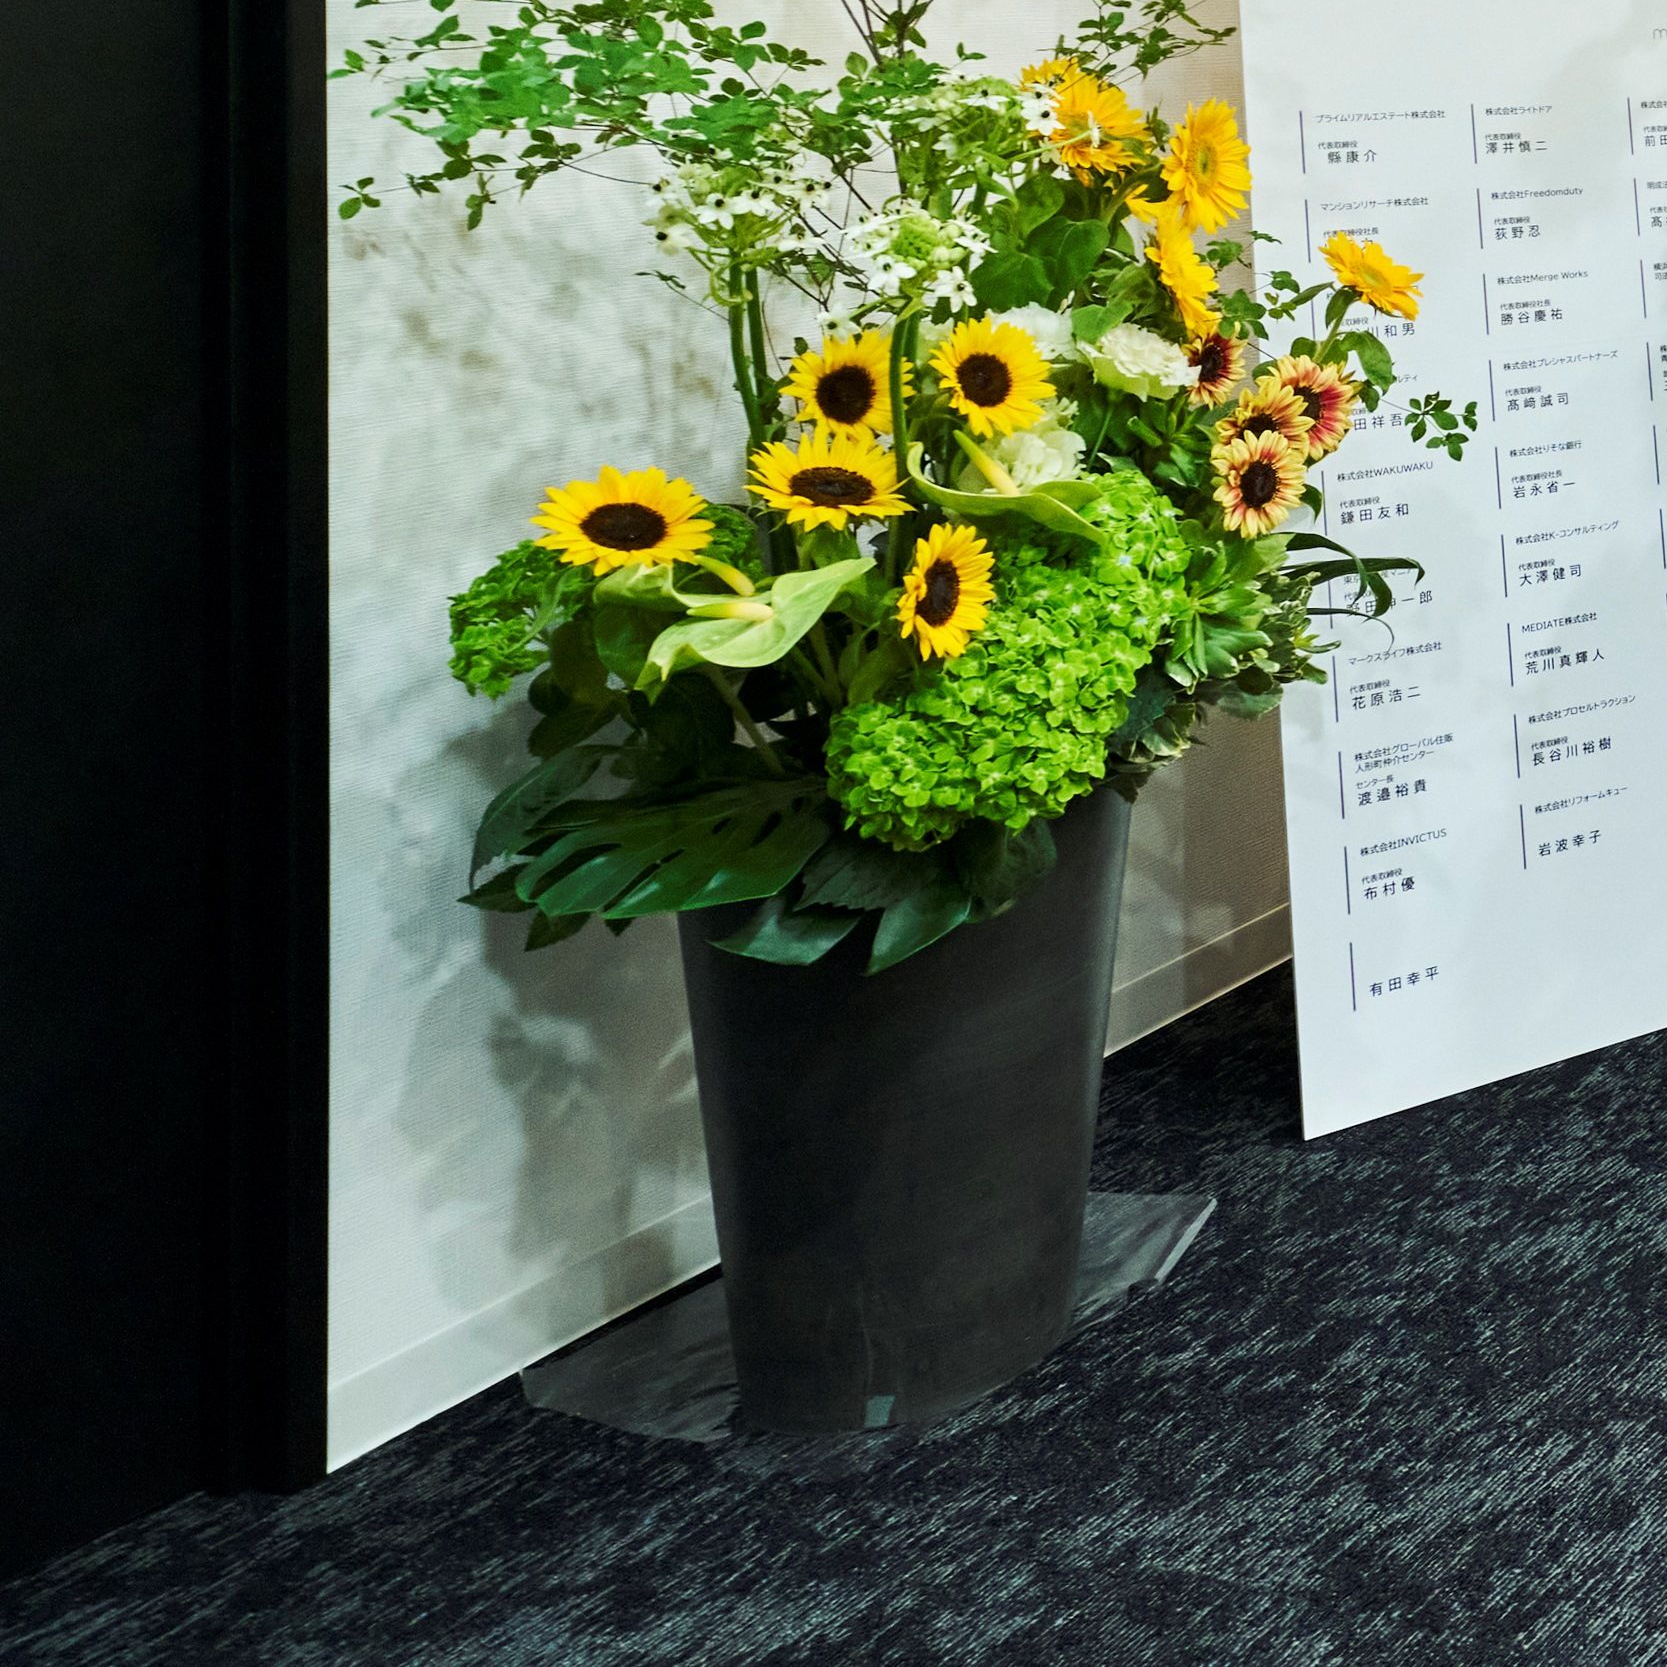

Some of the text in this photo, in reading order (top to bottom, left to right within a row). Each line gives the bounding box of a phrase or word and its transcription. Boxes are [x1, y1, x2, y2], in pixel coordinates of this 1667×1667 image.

[1315, 110, 1447, 124] プライムリアルエステート株式会社
[1485, 105, 1552, 116] 株式会社ライトドア
[1318, 140, 1358, 150] 代表取締役
[1485, 132, 1521, 141] 代表取締役
[1491, 187, 1583, 200] 株式会社Freedomduty
[1320, 196, 1430, 212] マンションリサーチ株式会社
[1494, 216, 1530, 225] 代表取締役
[1497, 270, 1588, 285] 株式会社Merge Works
[1500, 299, 1551, 311] 代表取締役社長
[1503, 350, 1618, 371] 株式会社プレシャスパートナーズ
[1505, 386, 1541, 396] 代表取締役
[1354, 413, 1403, 431] 田祥吾
[1510, 440, 1582, 458] 株式会社りそな銀行
[1337, 461, 1434, 482] 株式会社WAKUWAKU
[1511, 470, 1563, 484] 代表取締役社長
[1513, 481, 1576, 499] 岩永省一
[1340, 496, 1380, 509] 代表取締役
[1340, 503, 1409, 525] 鎌田友和
[1515, 520, 1619, 545] 株式会社K-コンサルティング
[1518, 558, 1556, 572] 代表取締役
[1519, 563, 1582, 587] 大澤健司
[1522, 612, 1598, 633] MEDIATE株式会社
[1348, 641, 1442, 665] マークスライフ株式会社
[1524, 646, 1562, 659] 代表取締役
[1526, 648, 1605, 675] 荒川真輝人
[1350, 679, 1390, 693] 代表取締役
[1352, 686, 1421, 710] 花原浩二
[1528, 694, 1636, 724] 株式会社プロセルトラクション
[1355, 733, 1454, 761] 株式会社グローバル住販
[1531, 736, 1568, 751] 代表取締役
[1532, 736, 1612, 766] 長谷川裕樹
[1355, 751, 1435, 774] 人形町仲介センター
[1356, 774, 1394, 790] センター長
[1535, 786, 1628, 814] 株式会社リフォームキュー
[1360, 828, 1447, 856] 株式会社INVICTUS
[1539, 829, 1602, 856] 岩波幸子
[1362, 868, 1403, 884] 代表取締役
[1364, 876, 1415, 900] 布村優
[1369, 965, 1439, 997] 有田幸平
